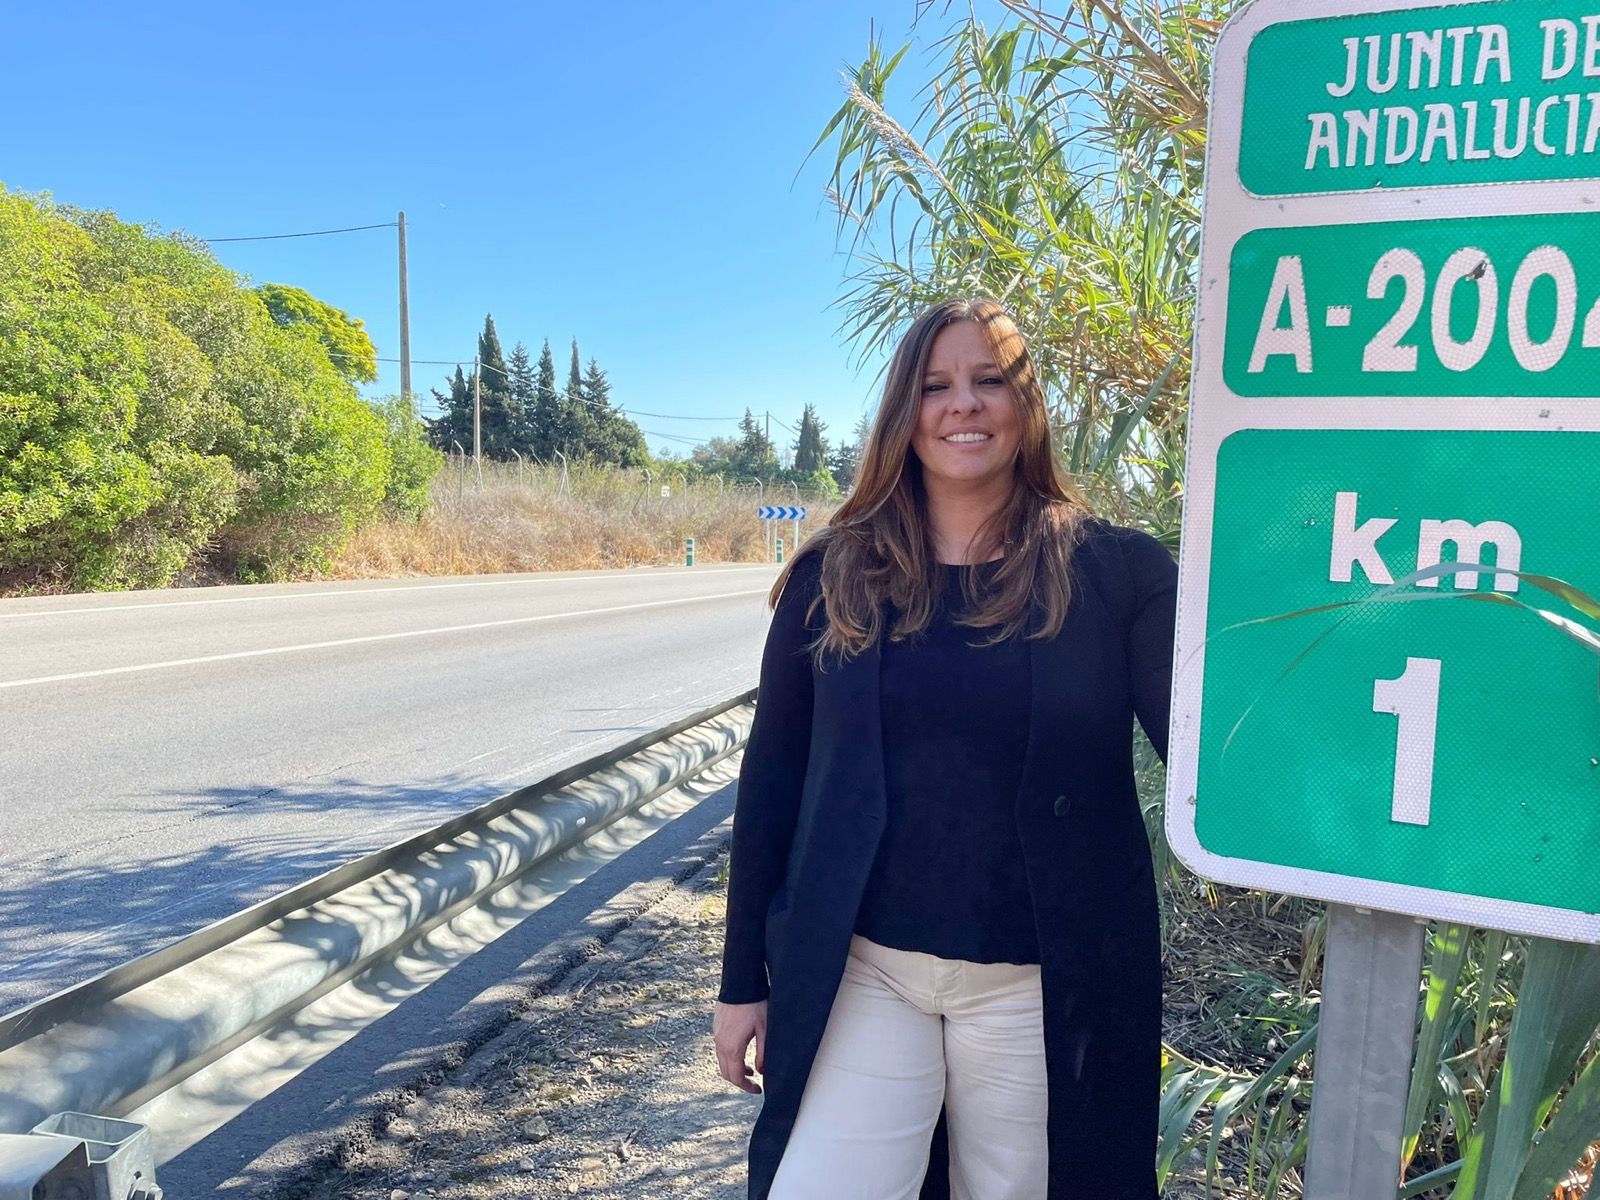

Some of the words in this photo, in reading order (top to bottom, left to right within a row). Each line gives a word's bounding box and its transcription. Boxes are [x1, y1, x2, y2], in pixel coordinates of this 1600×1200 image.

[1326, 24, 1511, 97] JUNTA
[1539, 15, 1600, 80] DE
[1329, 491, 1522, 592] km
[1372, 657, 1442, 826] 1
